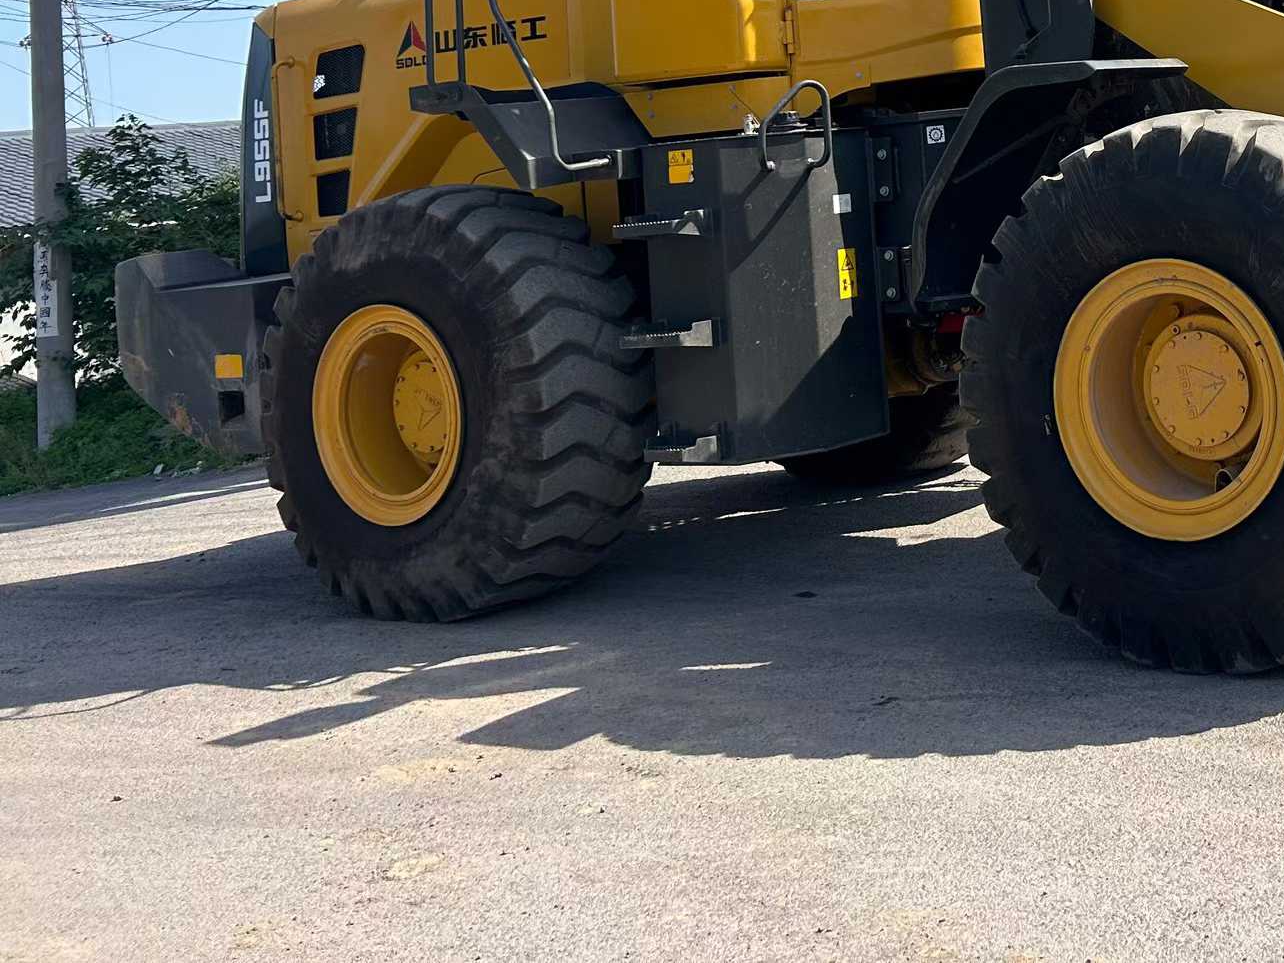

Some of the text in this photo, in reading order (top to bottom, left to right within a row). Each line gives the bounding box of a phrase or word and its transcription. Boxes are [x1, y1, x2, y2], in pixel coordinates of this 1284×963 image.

[435, 16, 547, 54] 山东临工
[254, 98, 272, 203] L955F
